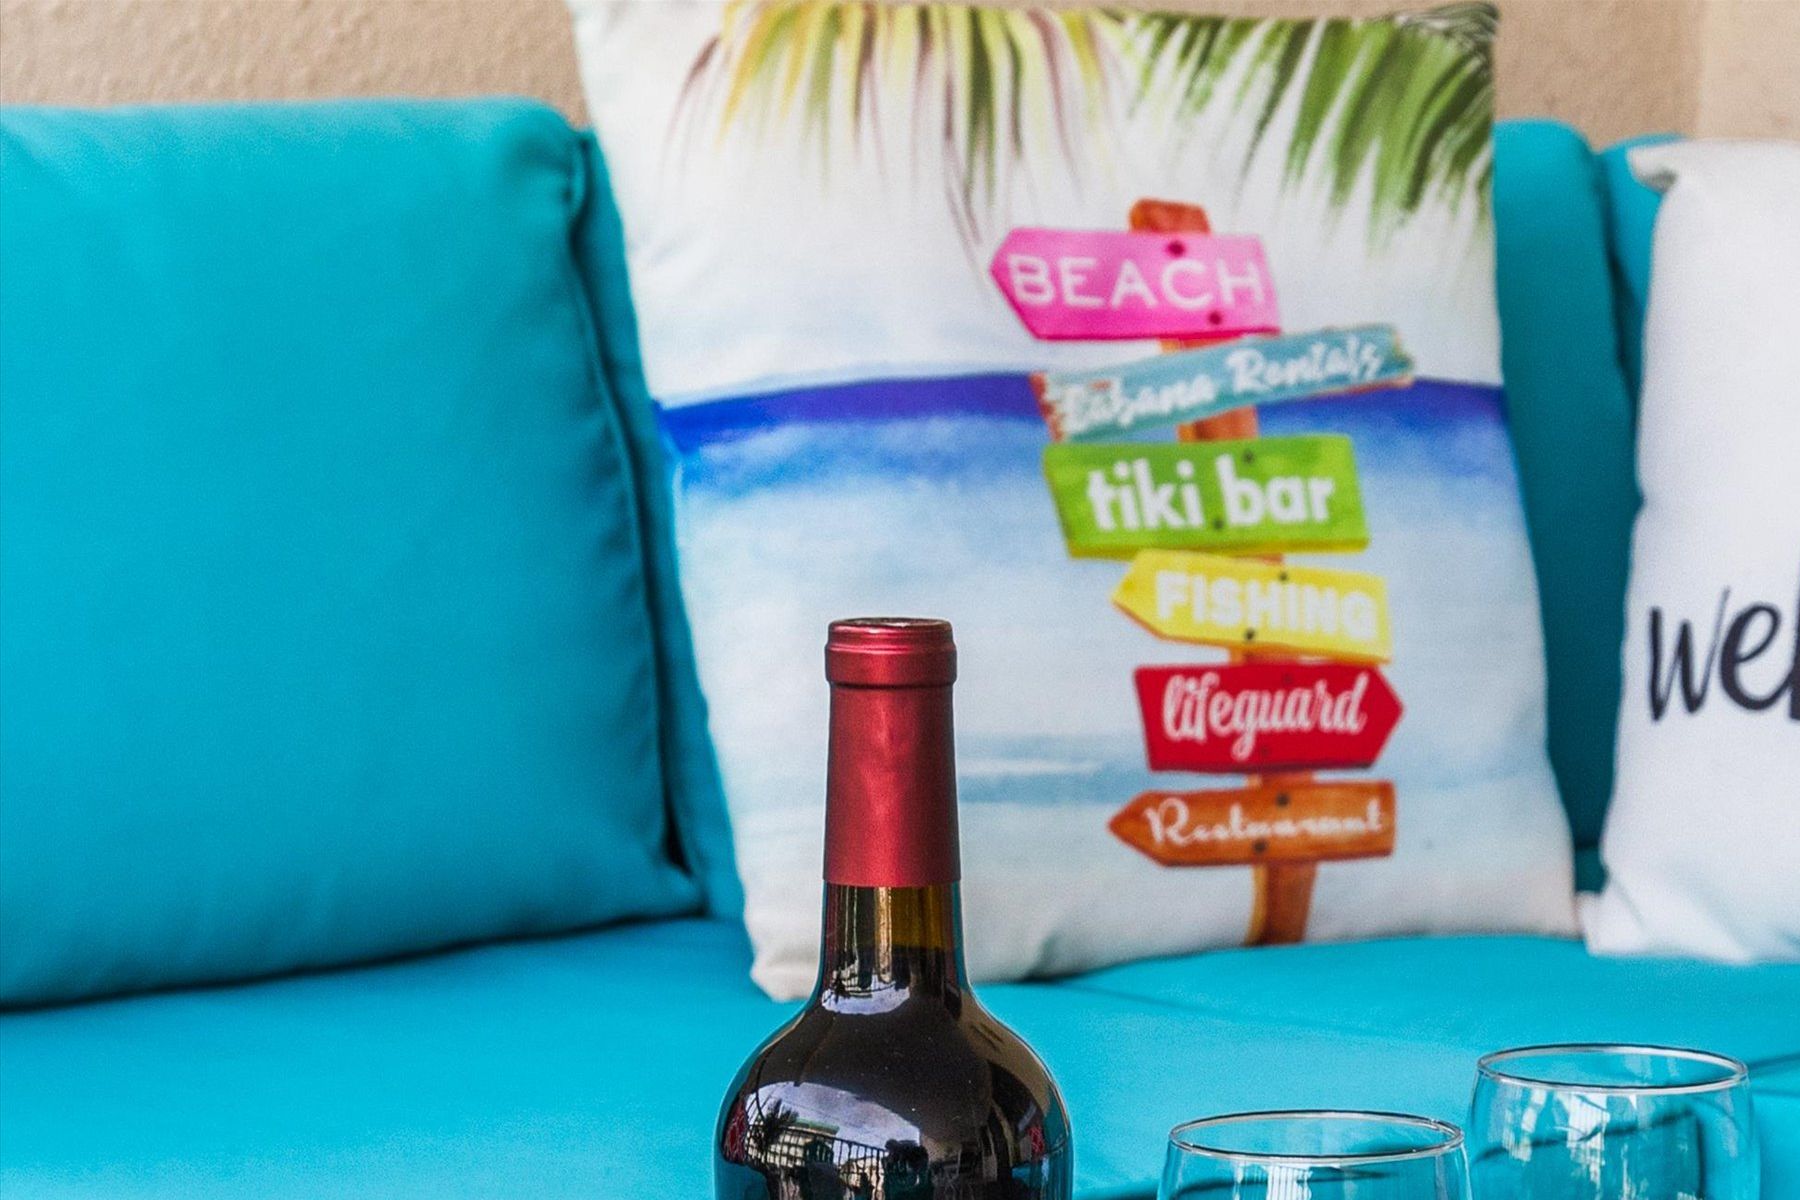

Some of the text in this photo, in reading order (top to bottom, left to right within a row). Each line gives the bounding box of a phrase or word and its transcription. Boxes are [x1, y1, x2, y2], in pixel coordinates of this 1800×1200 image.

[1006, 252, 1267, 309] BEACH
[1225, 336, 1382, 394] Rentals
[1087, 455, 1335, 531] tiki bar
[1155, 570, 1379, 641] FISHING
[1162, 672, 1370, 761] lifeguard
